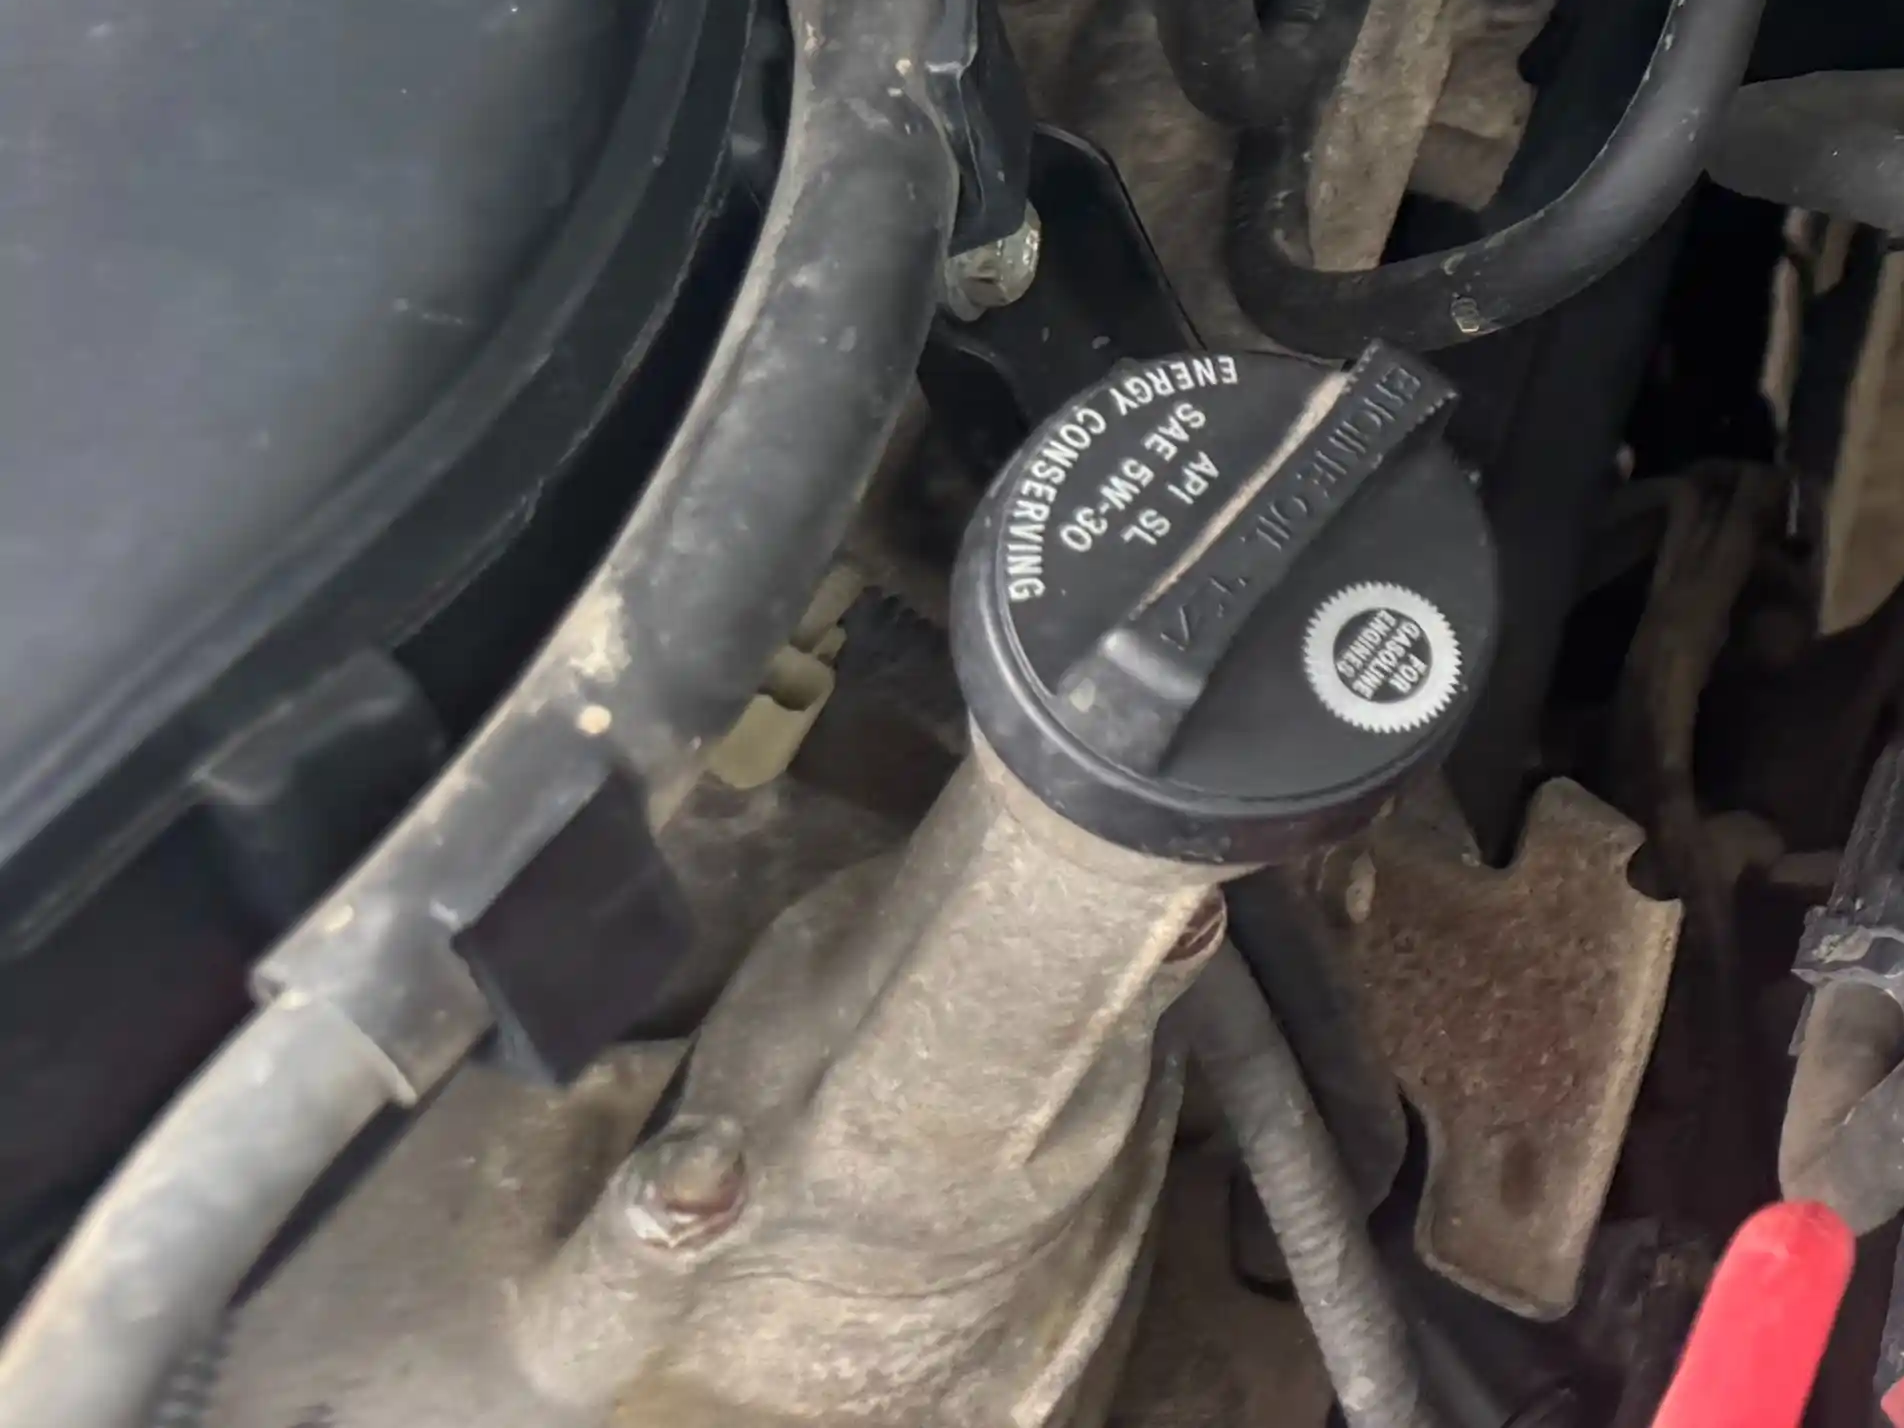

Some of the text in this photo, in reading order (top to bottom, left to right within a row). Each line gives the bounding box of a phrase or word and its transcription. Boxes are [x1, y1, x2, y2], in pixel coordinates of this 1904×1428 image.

[1005, 354, 1238, 603] ENERGY CONSERVING
[1060, 403, 1207, 554] SAE 5W-30
[1121, 451, 1220, 547] API SL
[1245, 362, 1423, 553] ENGINE OIL
[1335, 609, 1397, 678] ENGINES
[1352, 622, 1421, 699] GASOLINE
